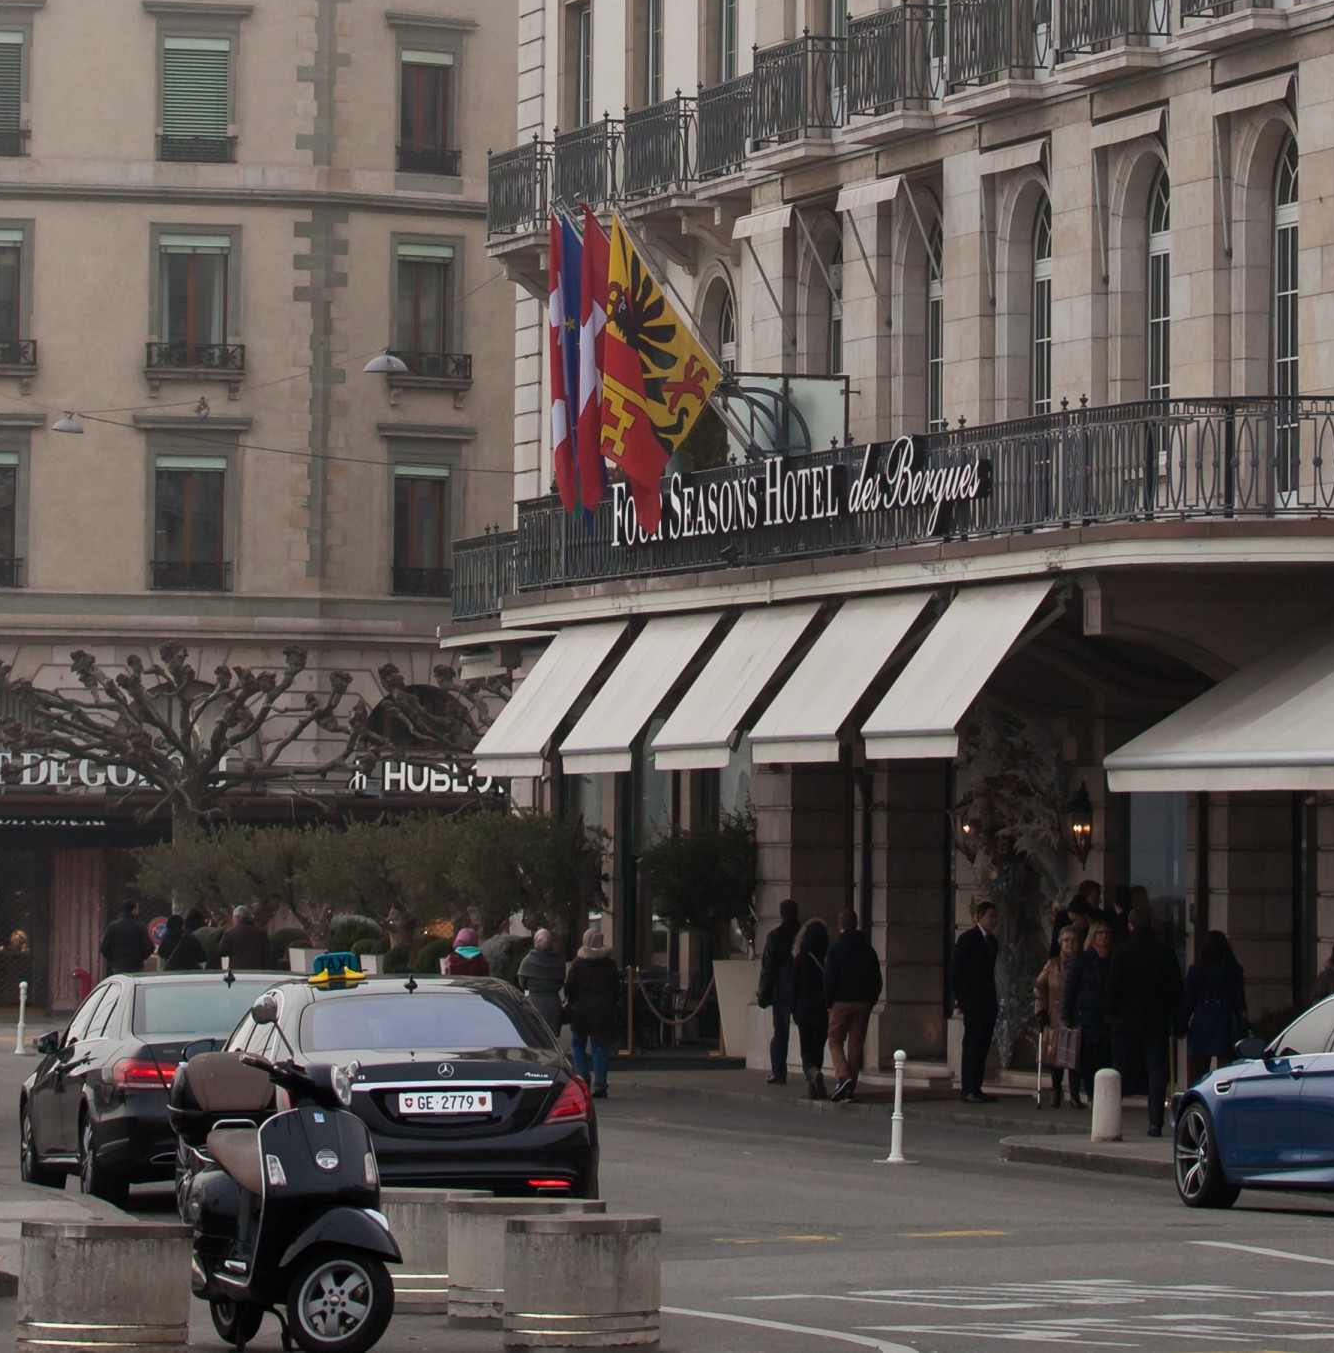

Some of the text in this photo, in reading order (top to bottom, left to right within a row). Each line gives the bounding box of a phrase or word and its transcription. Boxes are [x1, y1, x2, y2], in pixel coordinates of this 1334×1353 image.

[668, 471, 758, 541] SEASONS
[763, 455, 839, 527] HOTEL
[848, 443, 881, 514] des
[883, 434, 981, 537] Bergues
[20, 752, 73, 787] DE
[384, 760, 505, 794] HUBLO
[317, 953, 354, 974] TAXI
[417, 1094, 475, 1110] GE 2779
